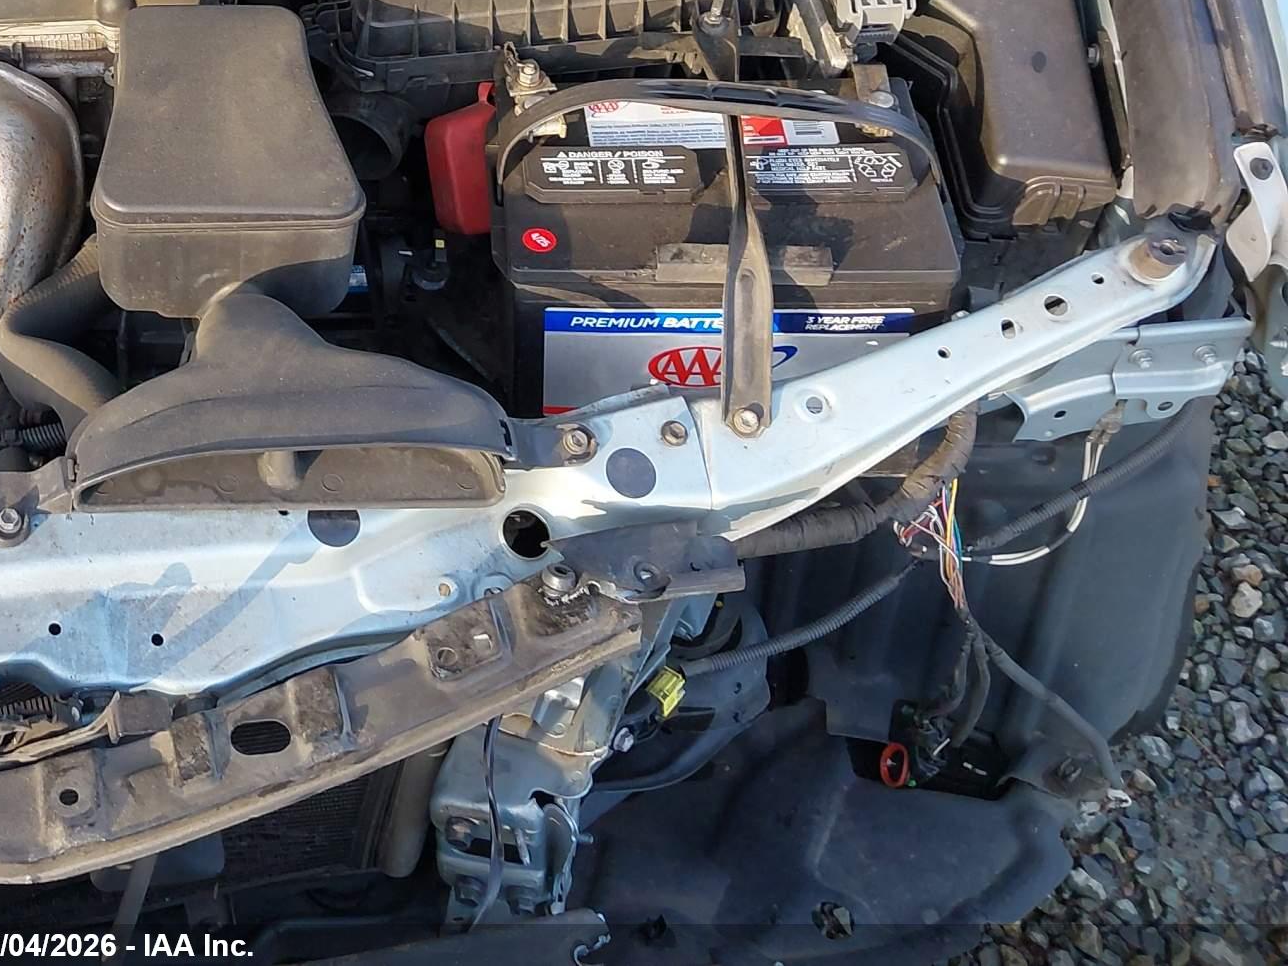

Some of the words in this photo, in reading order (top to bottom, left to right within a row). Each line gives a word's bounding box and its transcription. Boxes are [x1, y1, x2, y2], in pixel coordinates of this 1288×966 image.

[570, 316, 661, 328] PREMIUM
[663, 316, 724, 328] BATTE
[806, 316, 815, 324] 3
[817, 316, 850, 324] YEAR
[851, 315, 885, 324] FREE
[805, 323, 880, 331] REPLACEMENT
[660, 346, 721, 385] AA
